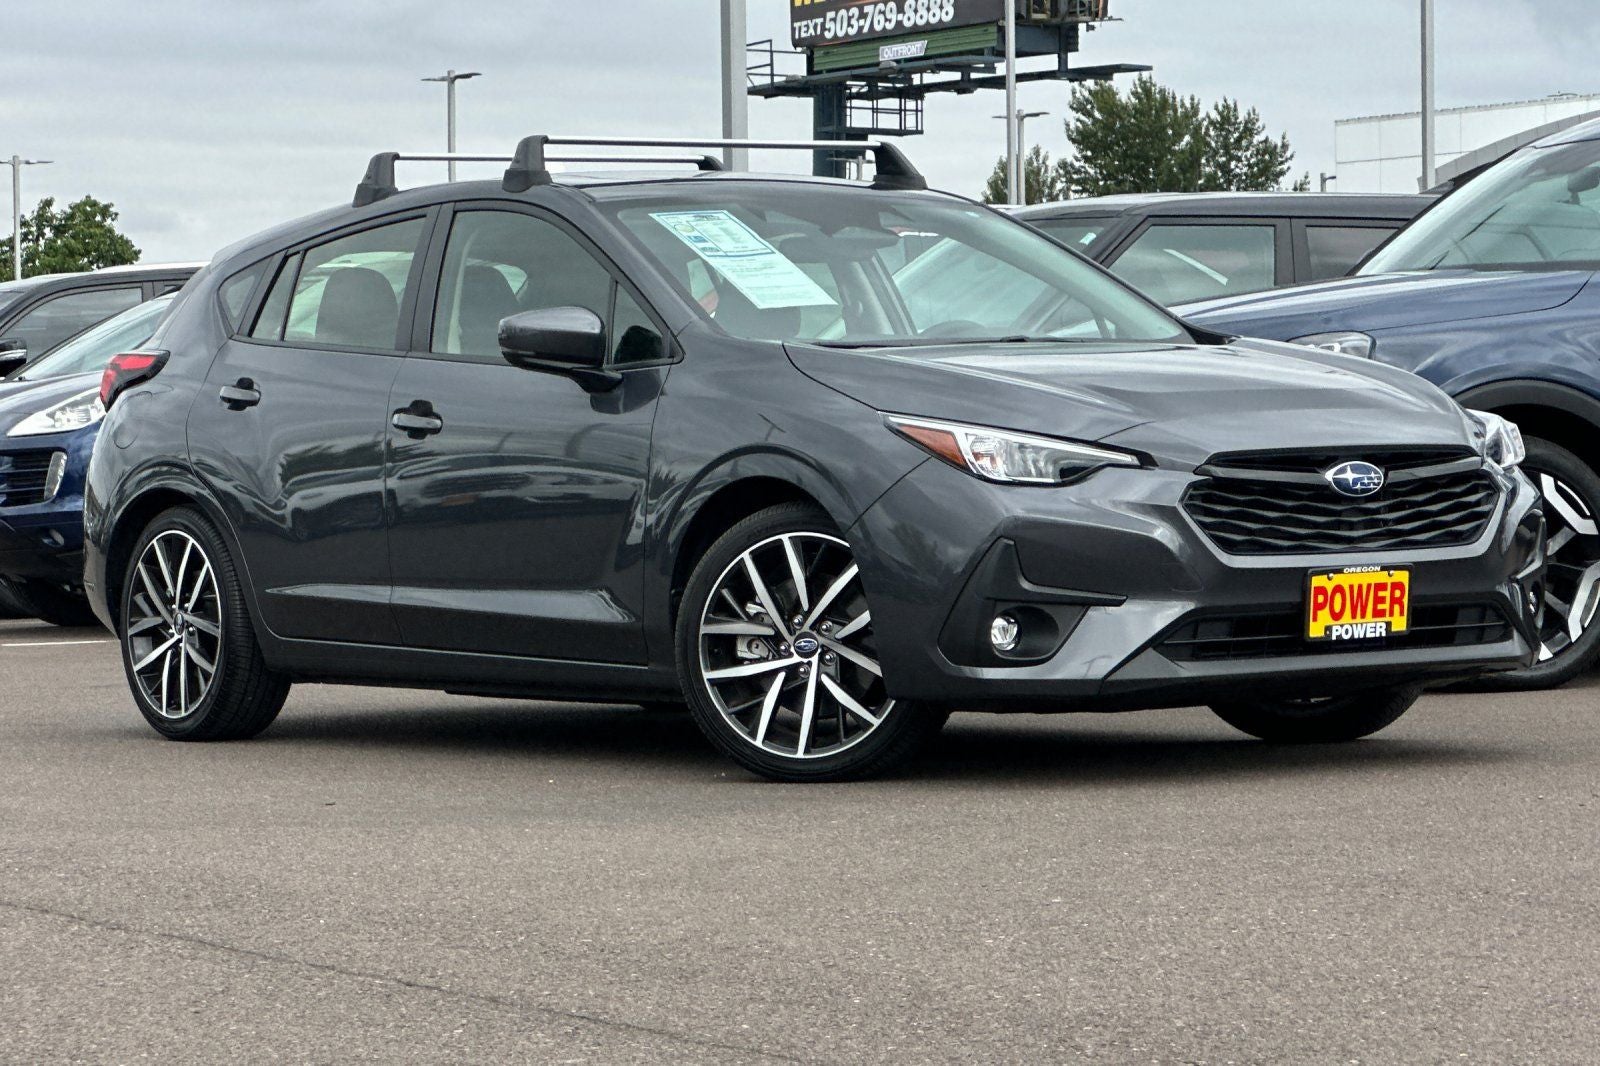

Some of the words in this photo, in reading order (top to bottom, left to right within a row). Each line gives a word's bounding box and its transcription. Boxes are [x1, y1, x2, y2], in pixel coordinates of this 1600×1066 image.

[793, 17, 824, 39] TEXT
[824, 0, 955, 39] 503-769-8888
[1343, 566, 1381, 574] OREGON
[1312, 581, 1406, 622] POWER
[1331, 622, 1387, 640] POWER
